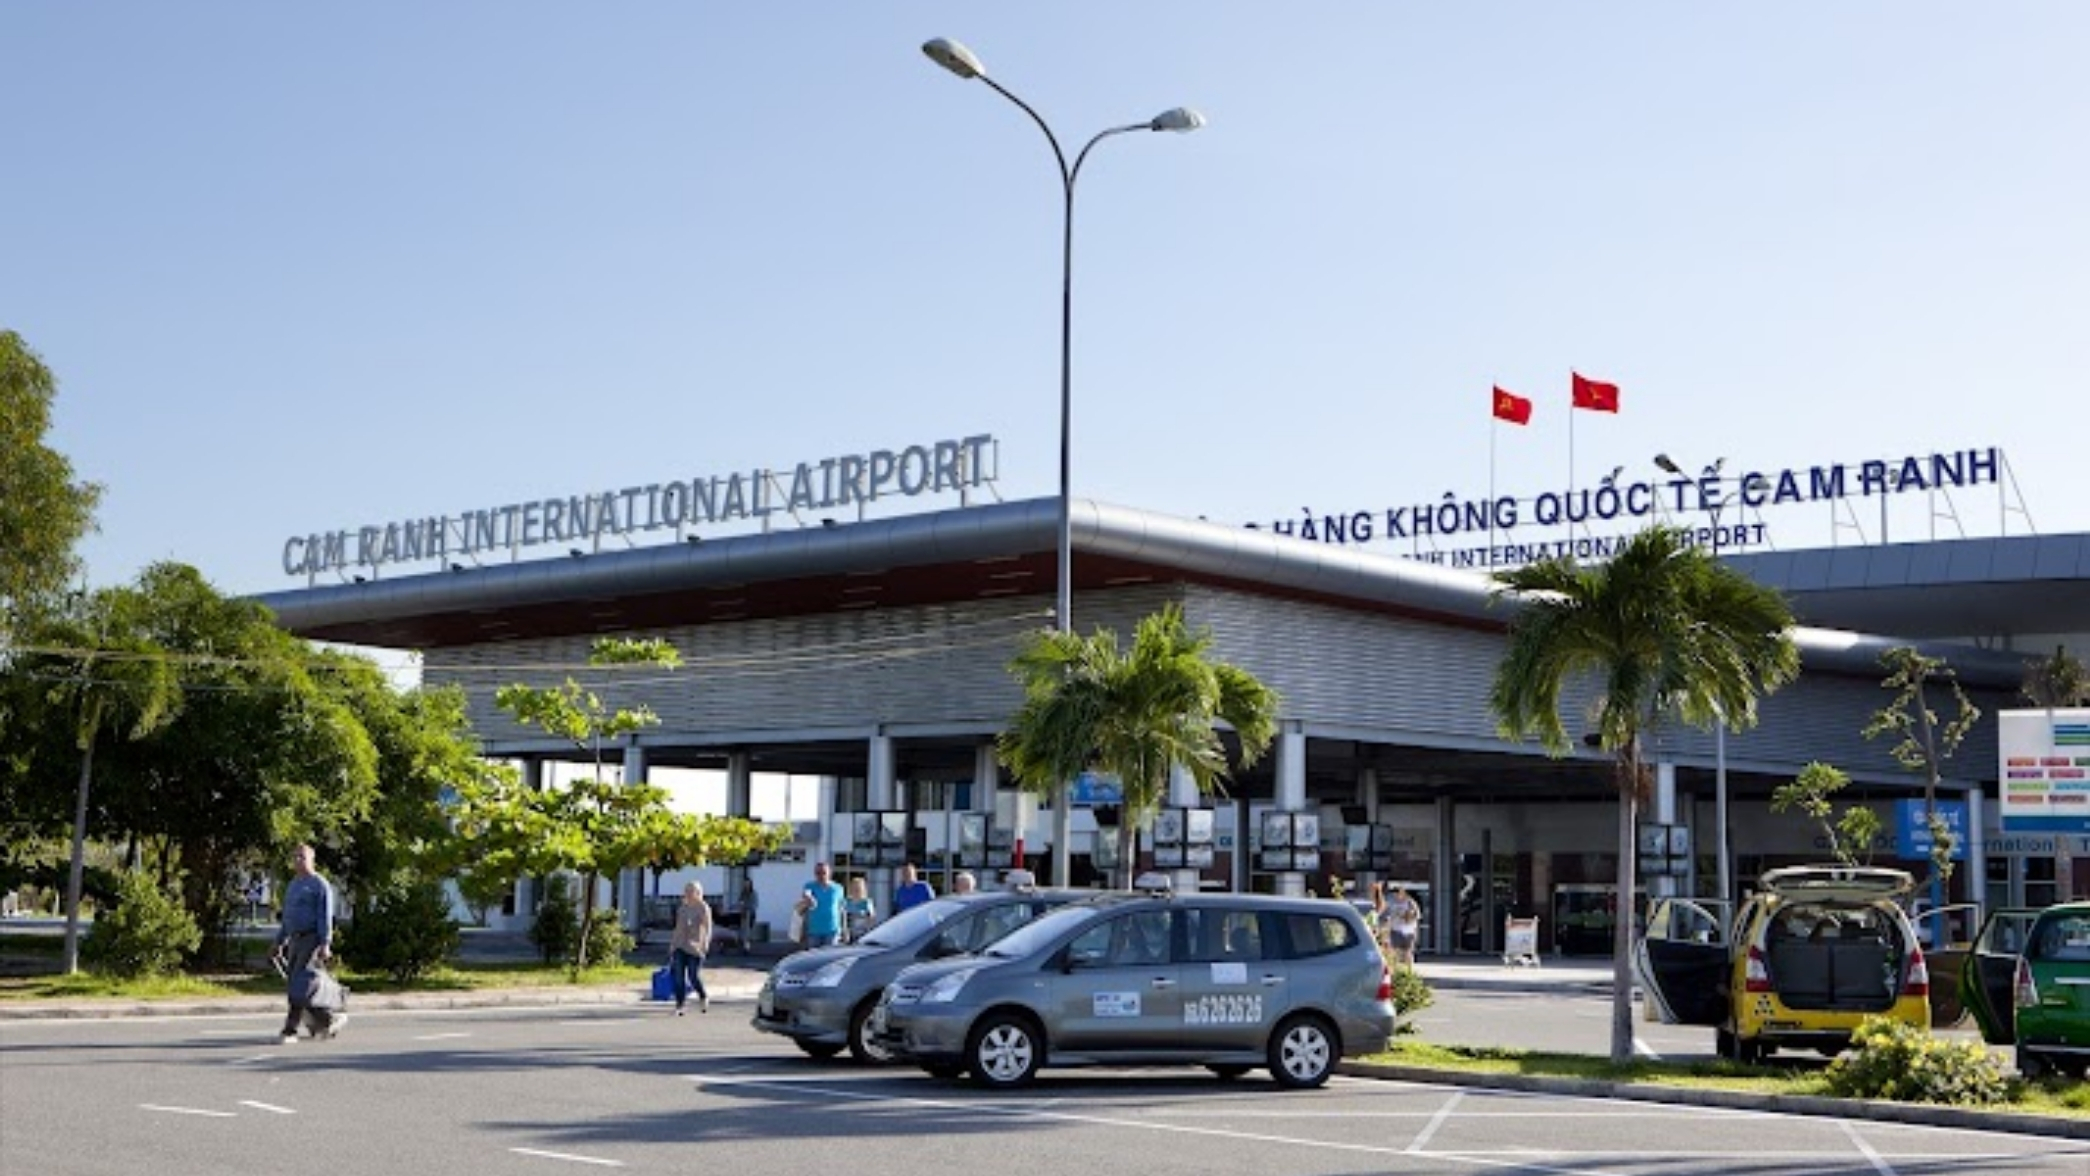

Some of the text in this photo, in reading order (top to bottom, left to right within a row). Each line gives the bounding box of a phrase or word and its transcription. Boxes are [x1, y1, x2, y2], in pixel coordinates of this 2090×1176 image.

[283, 433, 992, 575] CAM RANH INTERNATIONAL AIRPORT
[1386, 491, 1518, 540] KHÔNG
[1535, 465, 1651, 525] QUỐC
[1667, 456, 1726, 513] TẾ
[1742, 463, 1845, 507] CAM
[1862, 446, 1997, 496] RANH
[1452, 534, 1634, 567] INTERNATIONA
[1674, 523, 1766, 550] RPORT
